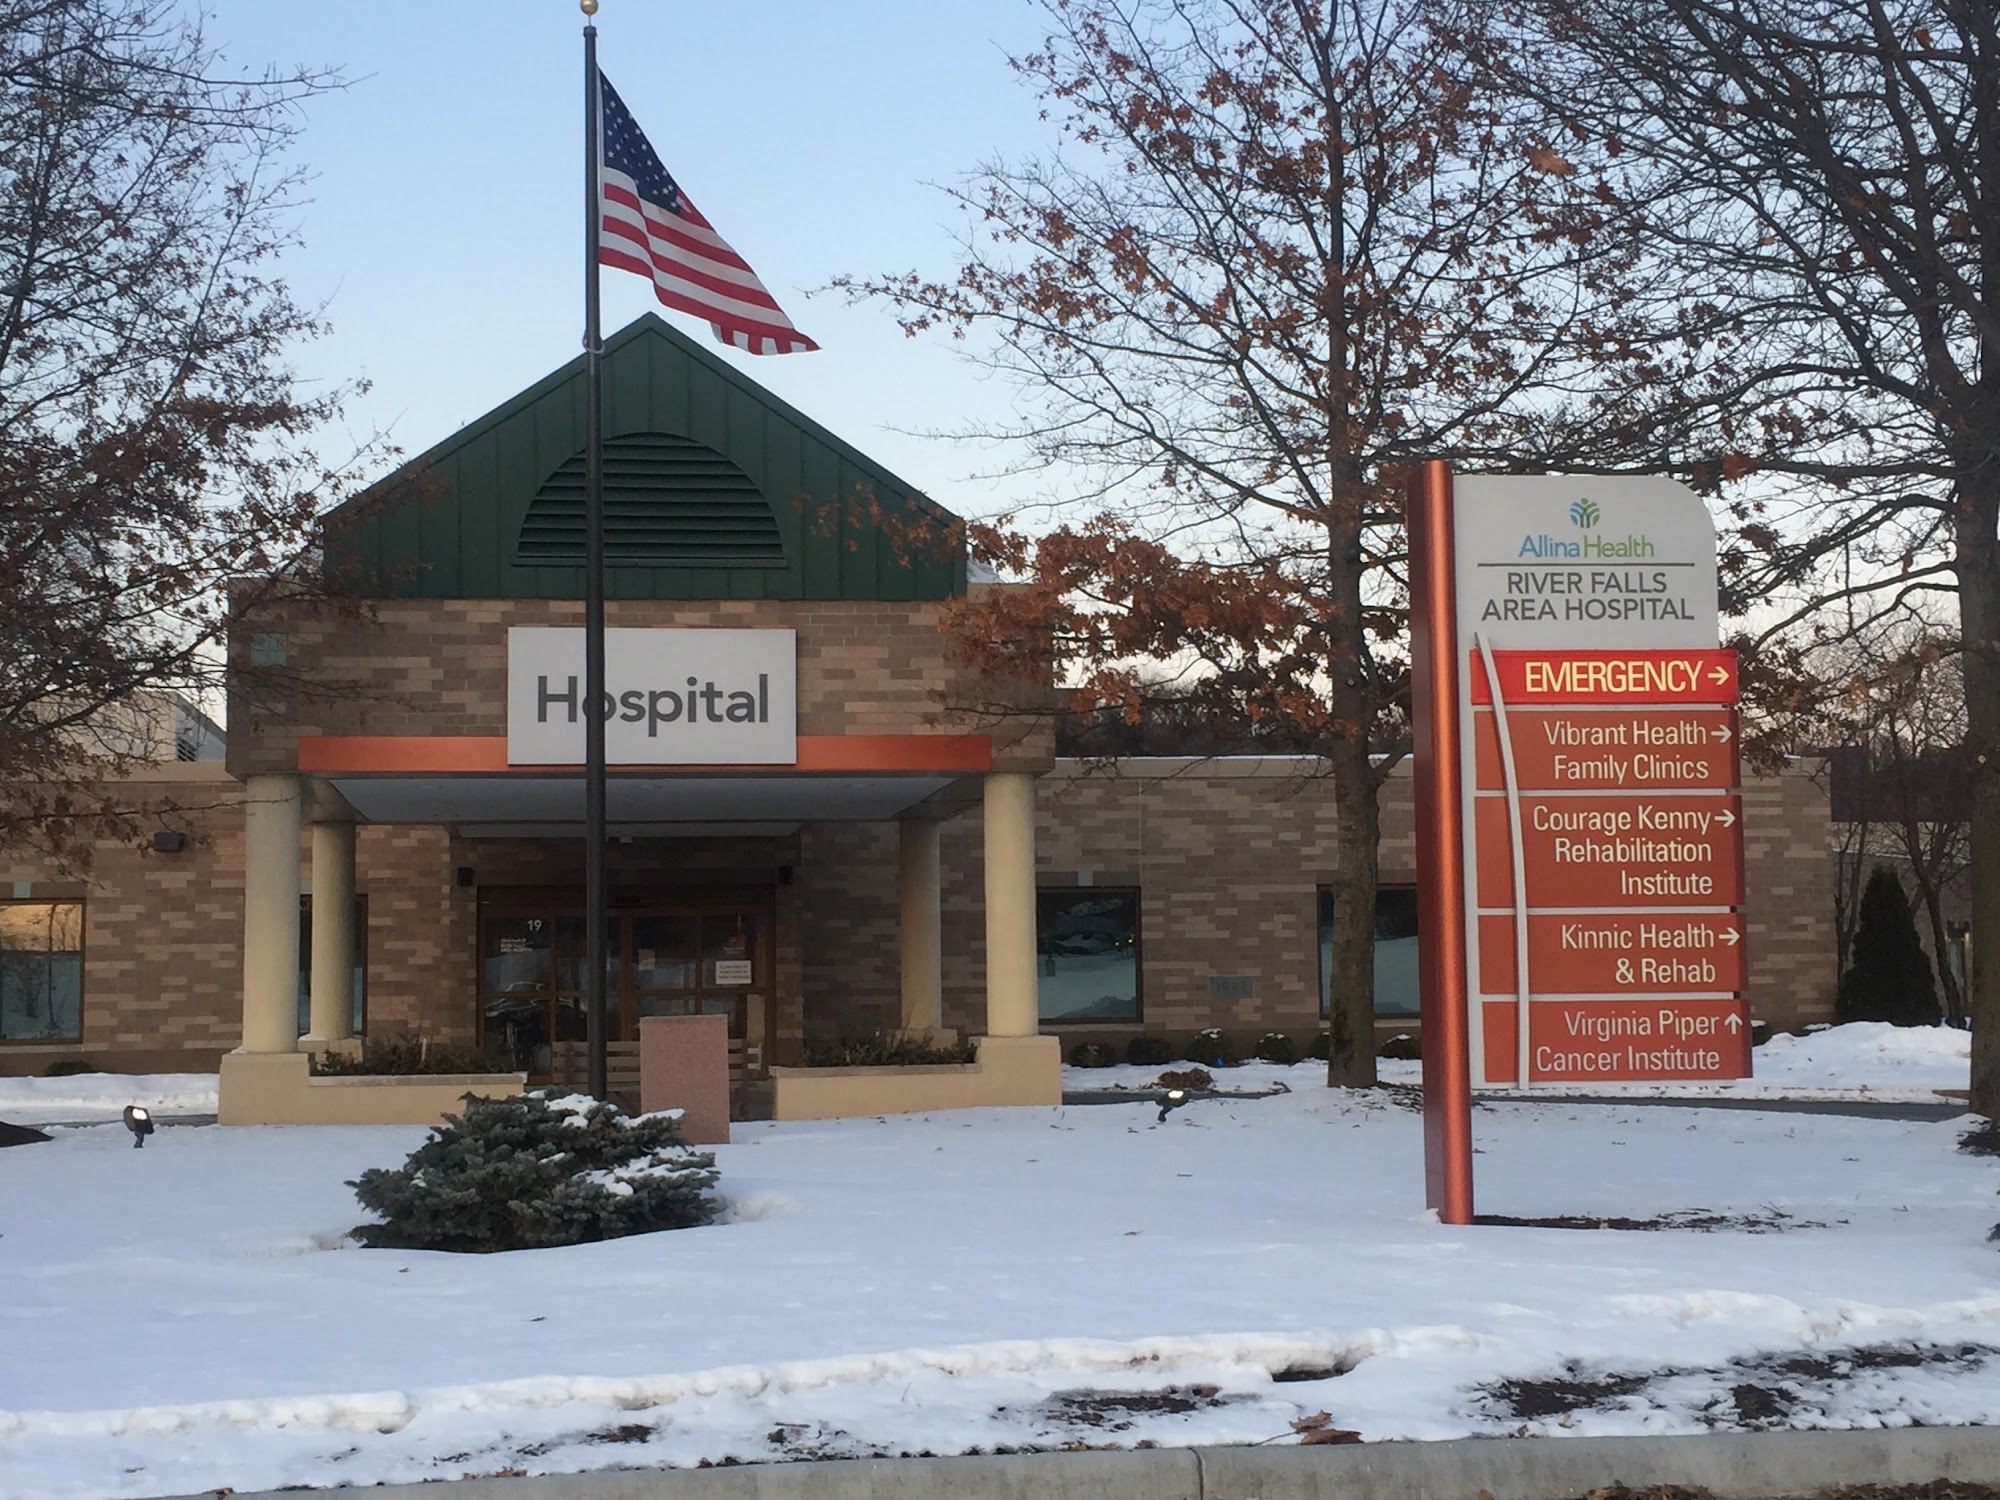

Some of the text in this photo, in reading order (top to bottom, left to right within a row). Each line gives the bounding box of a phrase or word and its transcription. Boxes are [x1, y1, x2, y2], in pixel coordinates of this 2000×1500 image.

[1518, 535, 1654, 558] Allina Health
[1507, 572, 1667, 594] RIVER FALLS
[1481, 599, 1695, 621] AREA HOSPITAL
[1525, 660, 1703, 693] EMERGENCY
[537, 673, 768, 737] Hospital
[1543, 720, 1707, 746] Vibrant Health
[1554, 754, 1709, 785] Family Clinics
[1533, 804, 1711, 835] Courage Kenny
[1555, 837, 1712, 864] Rehabilitation
[1621, 870, 1713, 896] Institute
[526, 919, 542, 931] 19
[1561, 922, 1715, 950] Kinnic Health
[1615, 958, 1716, 984] & Rehab
[1564, 1009, 1720, 1041] Virginia Piper
[1536, 1046, 1720, 1072] Cancer Institute
